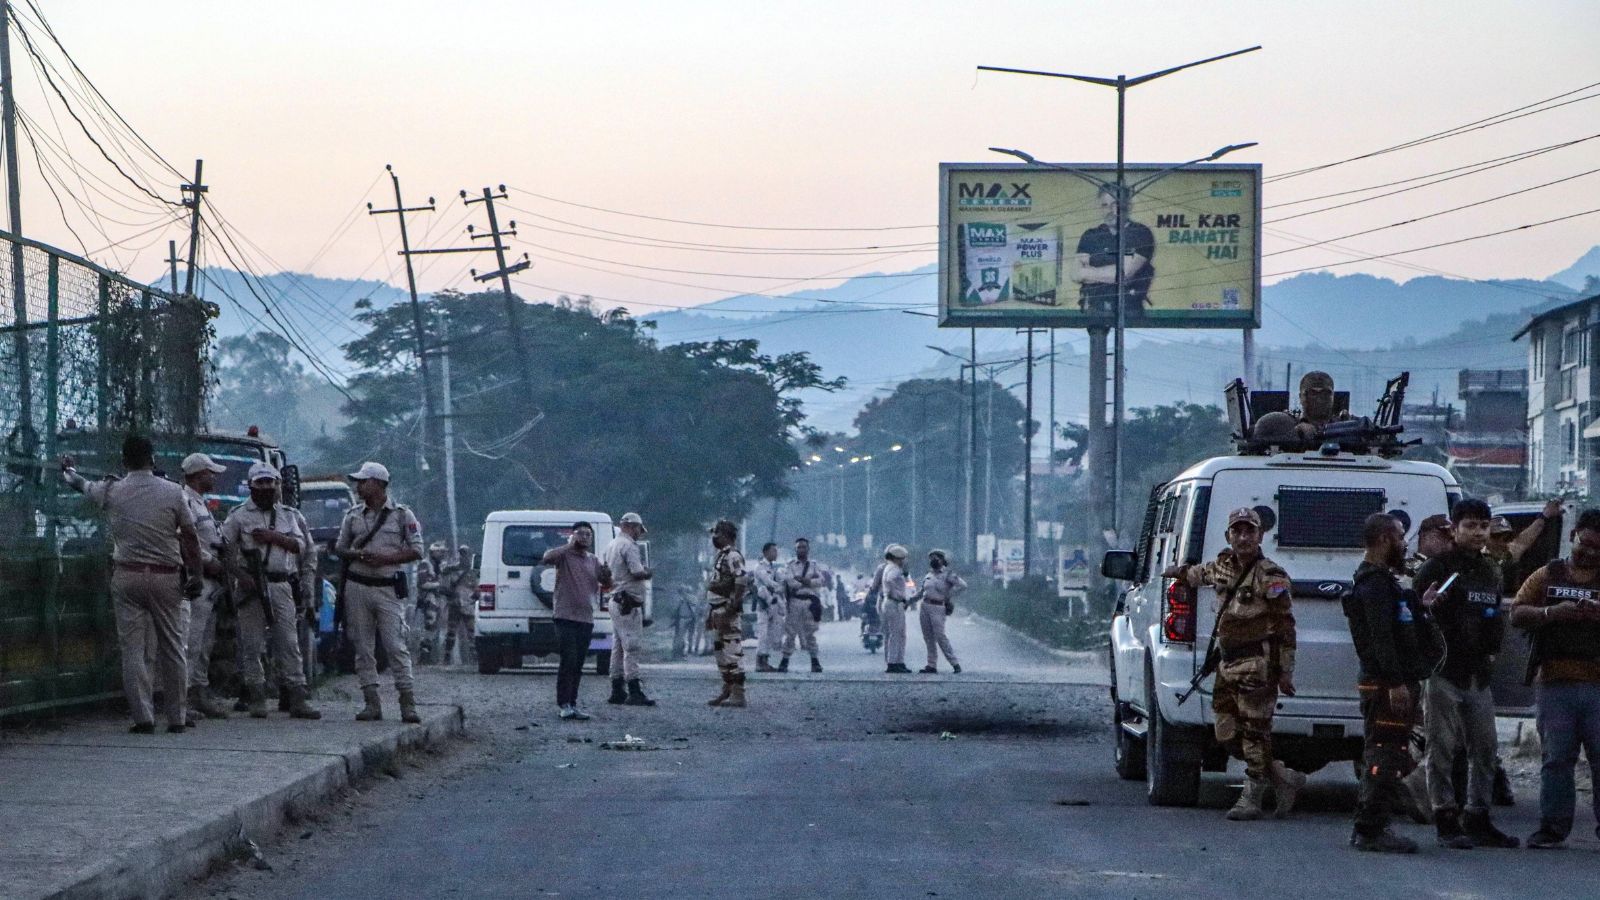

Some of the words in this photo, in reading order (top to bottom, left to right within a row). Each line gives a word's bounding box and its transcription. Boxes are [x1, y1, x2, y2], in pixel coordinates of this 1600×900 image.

[959, 182, 1032, 198] MAX
[1157, 214, 1191, 228] MIL
[1198, 214, 1240, 228] KAR
[970, 228, 1005, 237] MAX
[1168, 229, 1239, 243] BANATE
[1207, 245, 1238, 259] HAI
[1468, 591, 1497, 603] PRESS
[1555, 588, 1592, 598] PRESS
